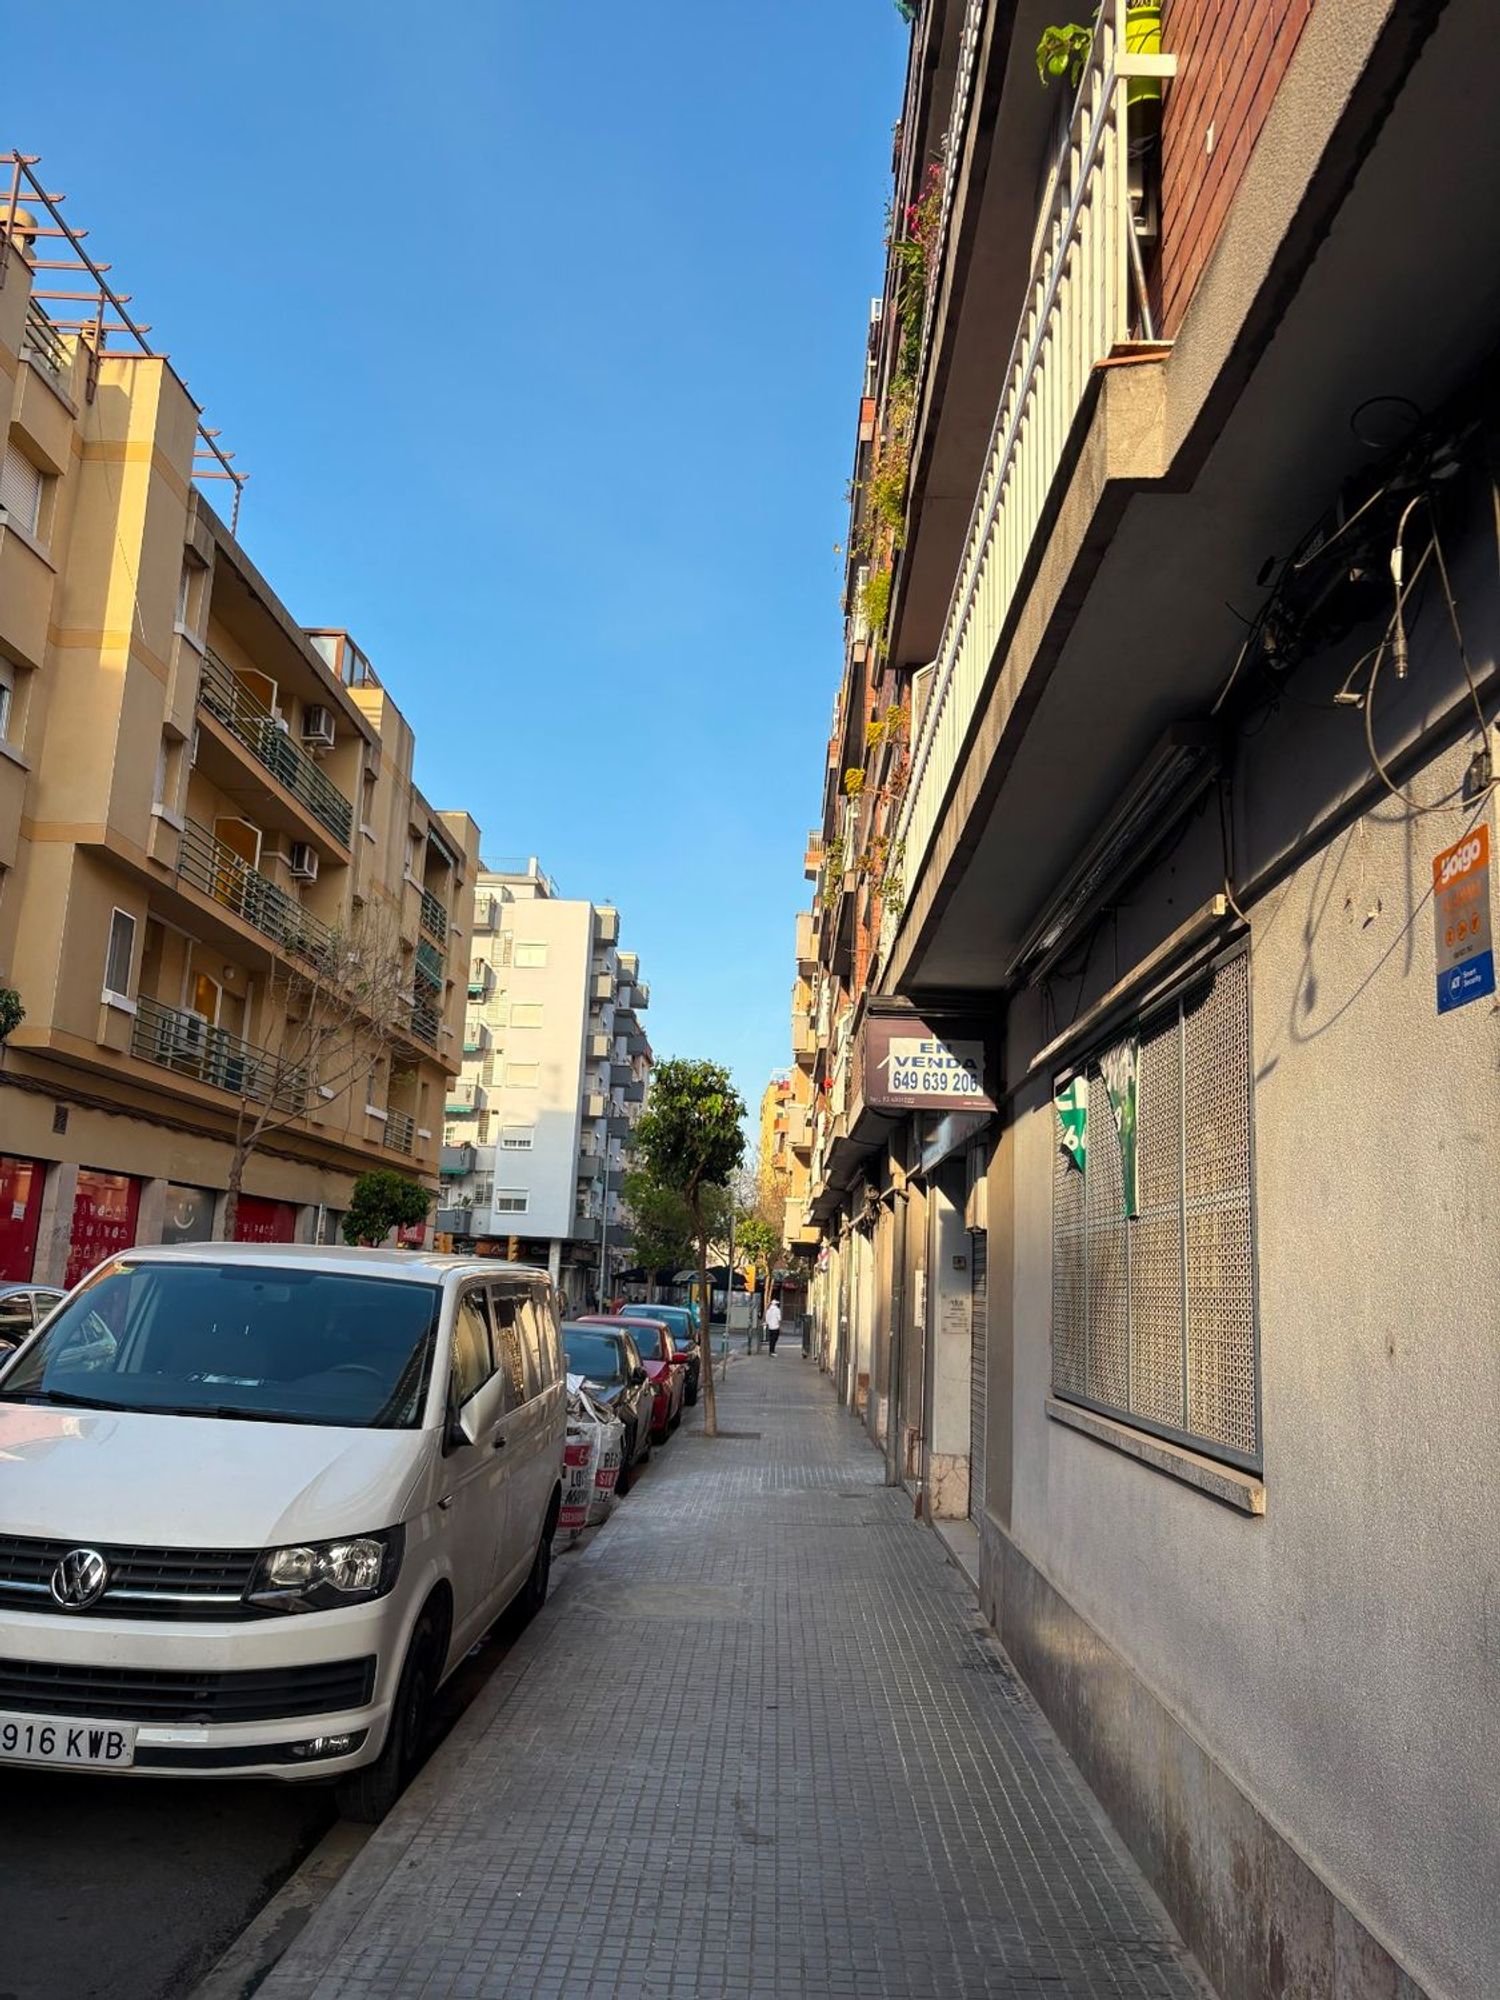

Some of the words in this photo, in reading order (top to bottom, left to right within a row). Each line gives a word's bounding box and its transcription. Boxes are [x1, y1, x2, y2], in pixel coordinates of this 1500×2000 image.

[920, 1042, 952, 1054] EN
[895, 1056, 978, 1069] VENDA
[893, 1071, 918, 1089] 649
[923, 1072, 948, 1090] 639
[952, 1073, 978, 1092] 206
[66, 1728, 123, 1760] KWB
